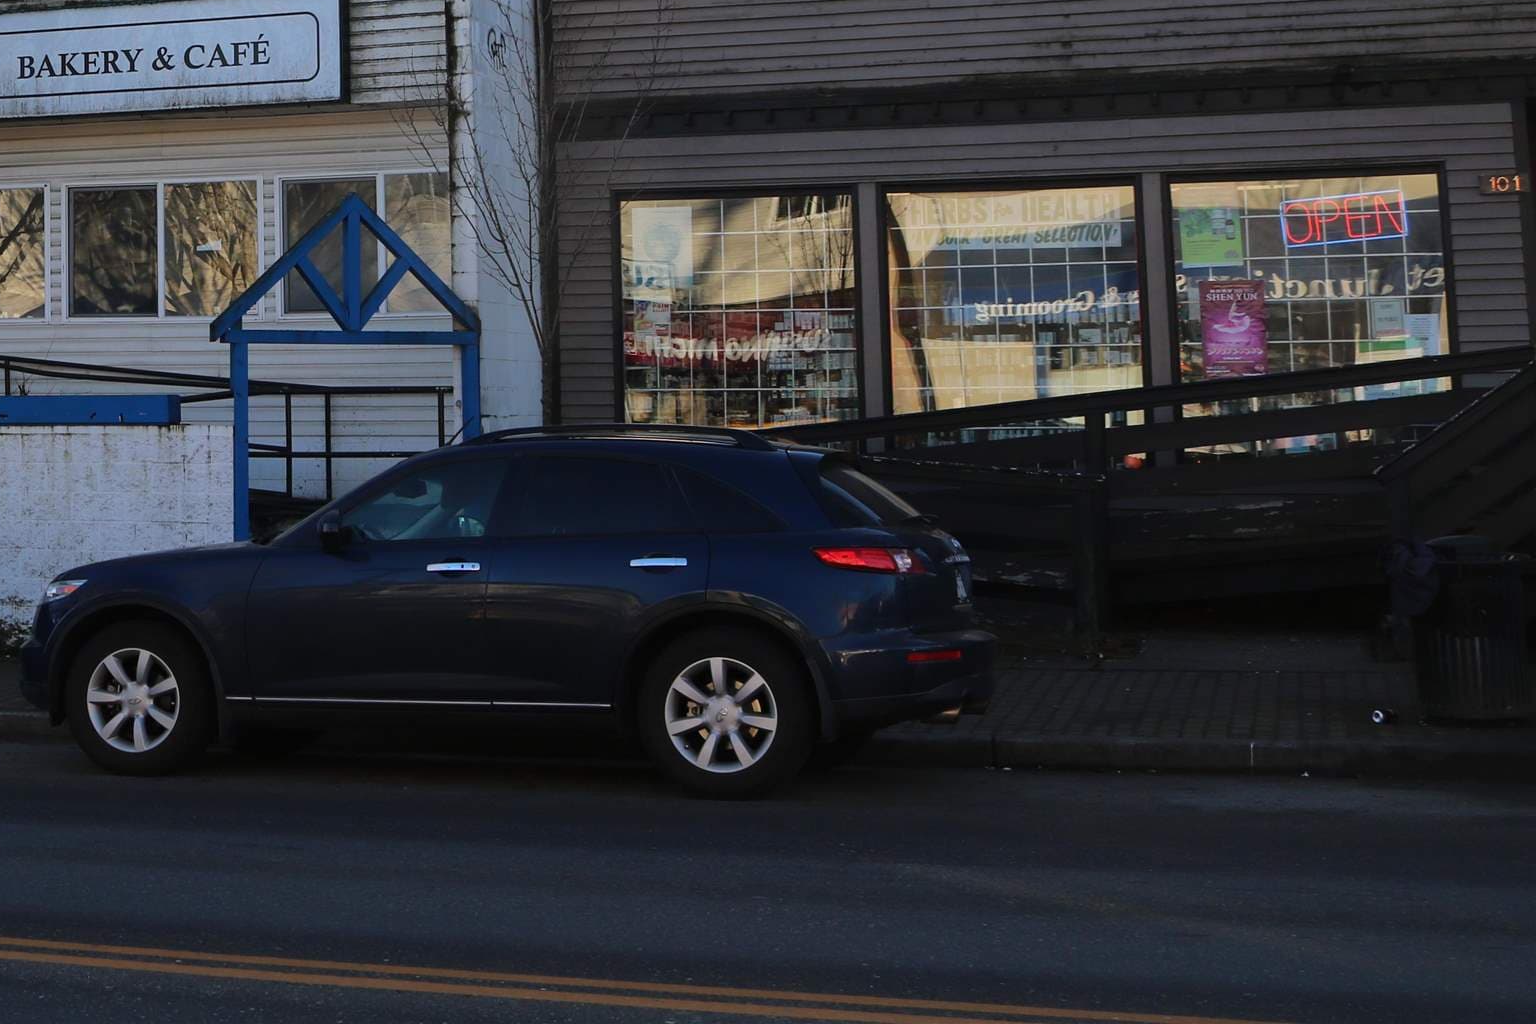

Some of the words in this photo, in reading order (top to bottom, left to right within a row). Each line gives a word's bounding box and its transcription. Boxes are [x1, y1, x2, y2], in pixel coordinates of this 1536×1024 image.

[16, 47, 143, 80] BAKERY
[151, 46, 175, 72] &
[184, 33, 271, 70] CAFÉ
[1488, 175, 1521, 192] 101
[1284, 190, 1405, 244] OPEN
[1205, 292, 1233, 302] SHEN
[1236, 292, 1258, 301] YUN
